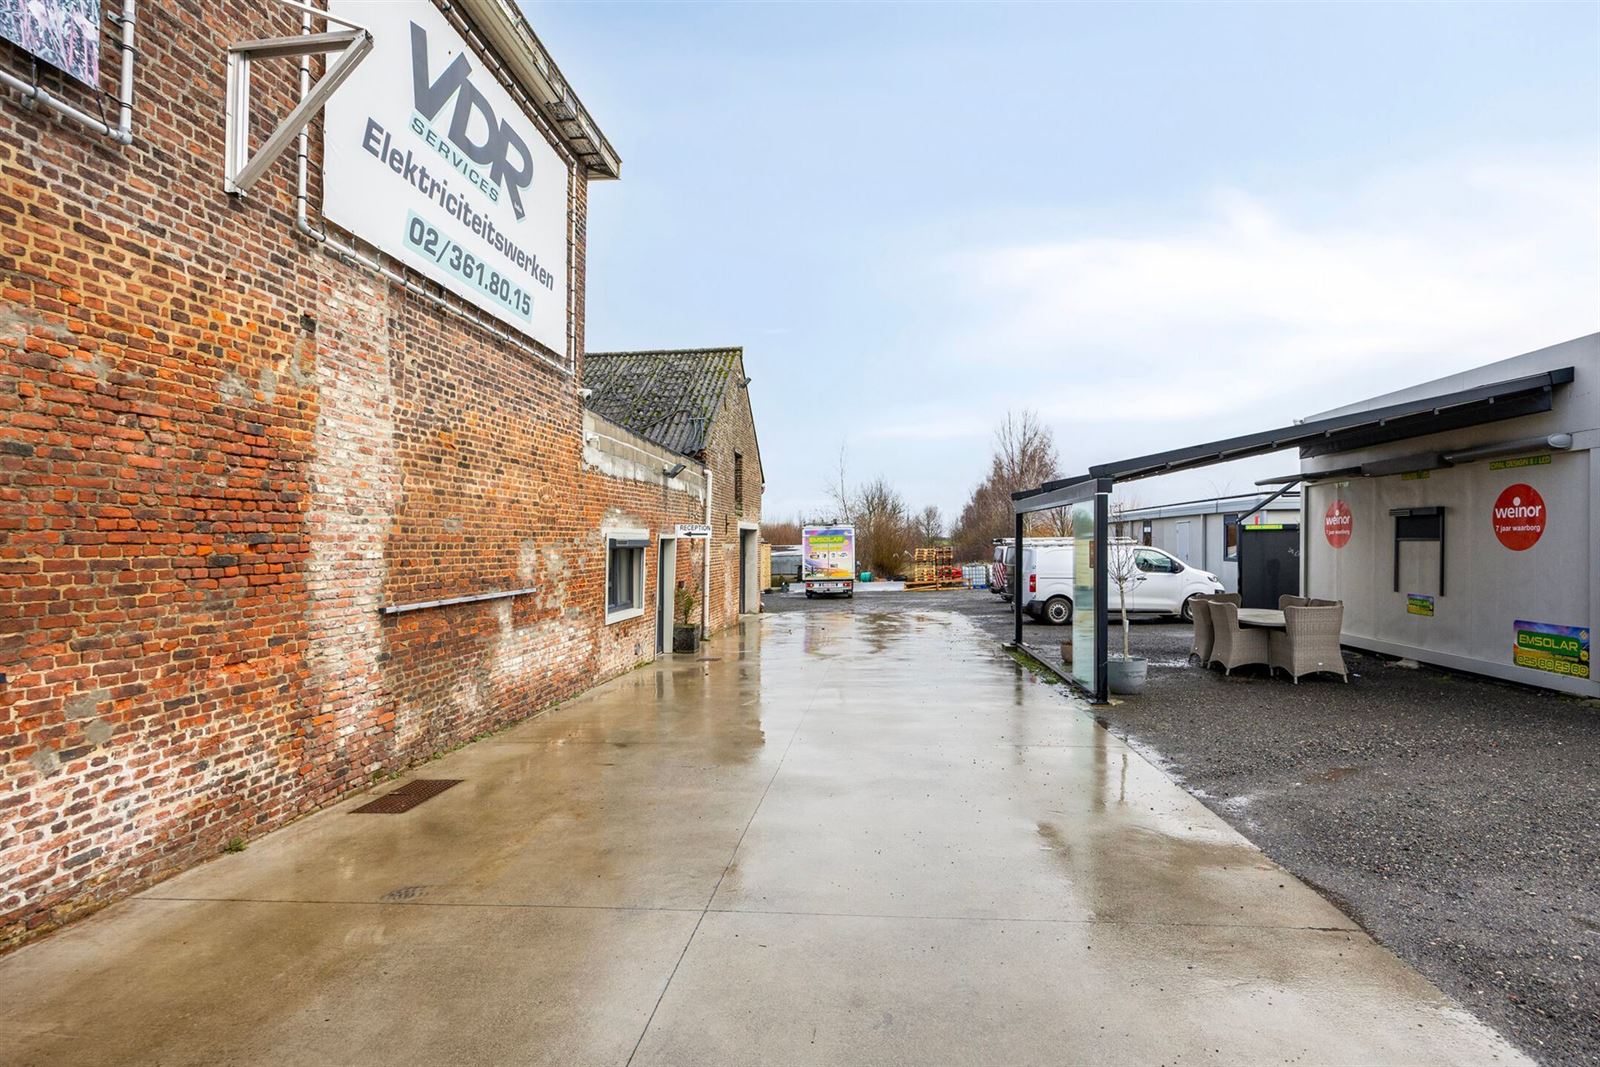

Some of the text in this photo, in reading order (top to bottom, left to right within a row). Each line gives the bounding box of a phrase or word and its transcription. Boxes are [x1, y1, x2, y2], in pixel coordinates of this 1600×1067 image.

[409, 20, 534, 221] VDR
[411, 117, 499, 203] SERVICES
[362, 116, 554, 291] Elektriciteitswerken
[409, 216, 531, 316] 02/361.80.15
[1325, 510, 1351, 525] weinor
[1495, 496, 1542, 518] weinor
[1500, 525, 1511, 533] jaar
[1512, 524, 1541, 533] waarborg
[1519, 634, 1578, 652] EMSOLAR
